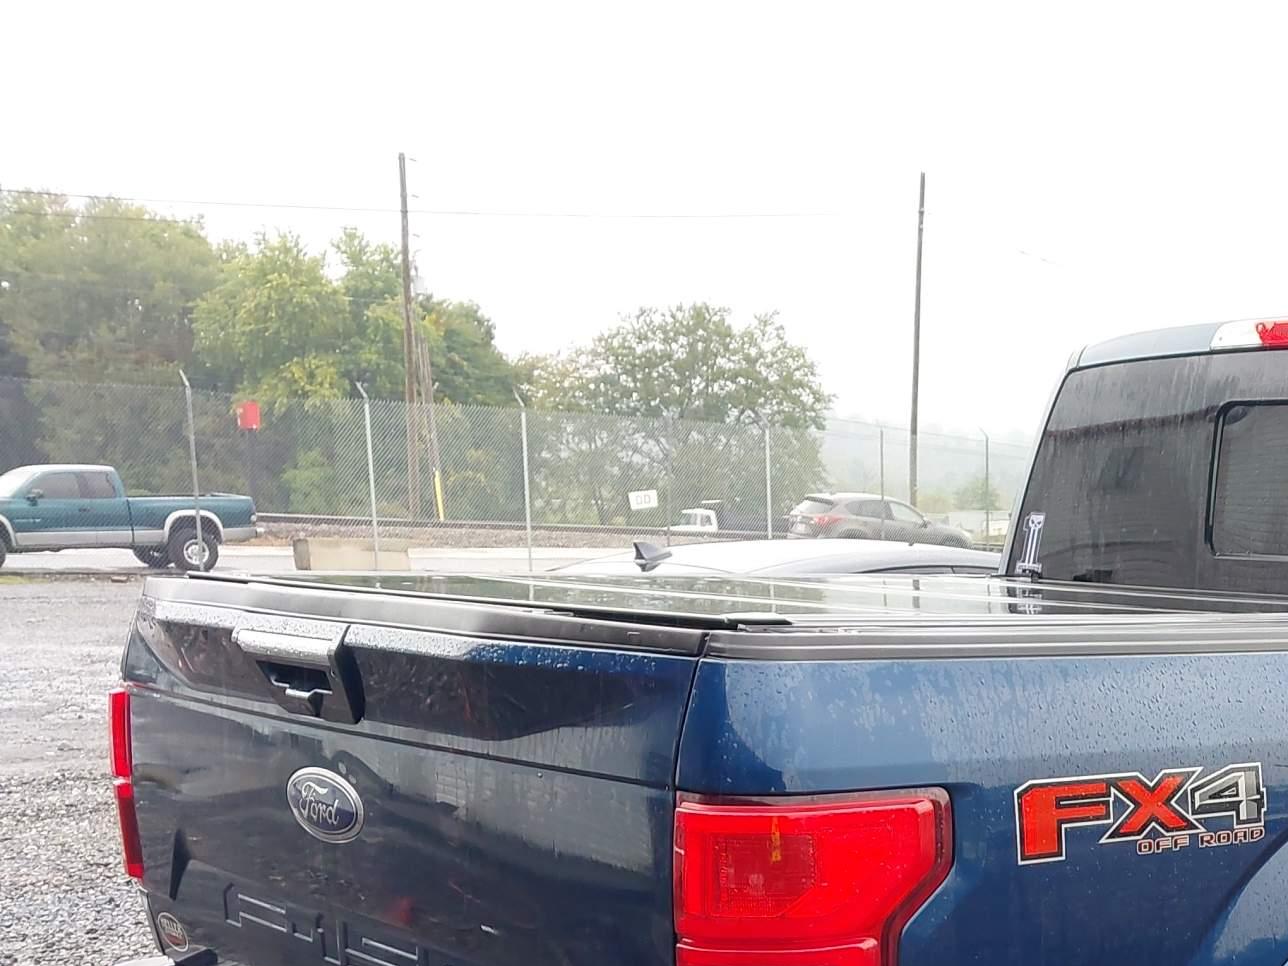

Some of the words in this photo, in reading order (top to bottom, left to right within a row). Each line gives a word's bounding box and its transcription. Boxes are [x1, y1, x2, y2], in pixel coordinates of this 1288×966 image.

[299, 780, 341, 826] Ford
[1014, 762, 1267, 865] FX4
[1136, 835, 1190, 855] OFF
[1199, 827, 1265, 848] ROAD
